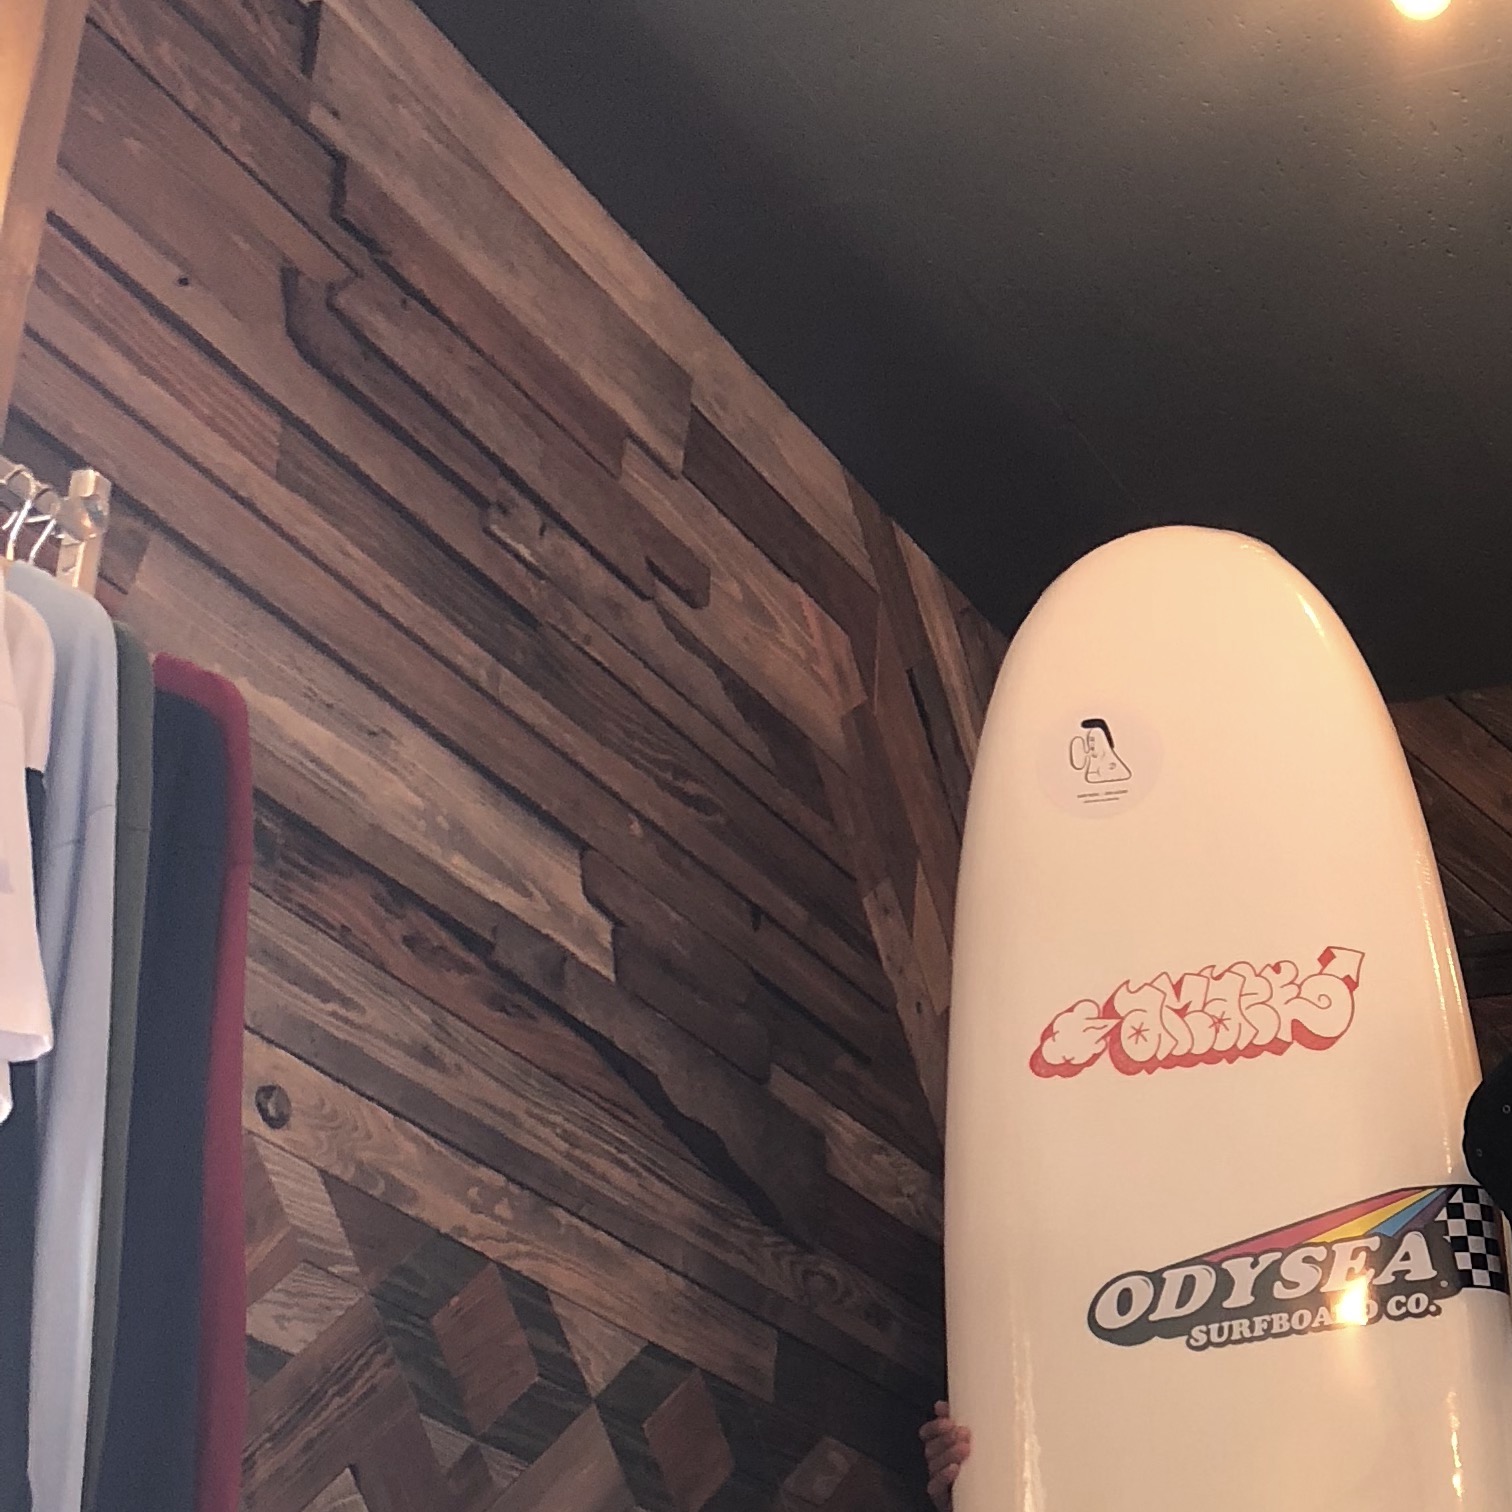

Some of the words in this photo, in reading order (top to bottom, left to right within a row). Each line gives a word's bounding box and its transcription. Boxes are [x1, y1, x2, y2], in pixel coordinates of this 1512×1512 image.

[1094, 1230, 1439, 1331] ODYSEA
[1190, 1299, 1380, 1348] SURFBOAD
[1386, 1292, 1437, 1317] CO.
